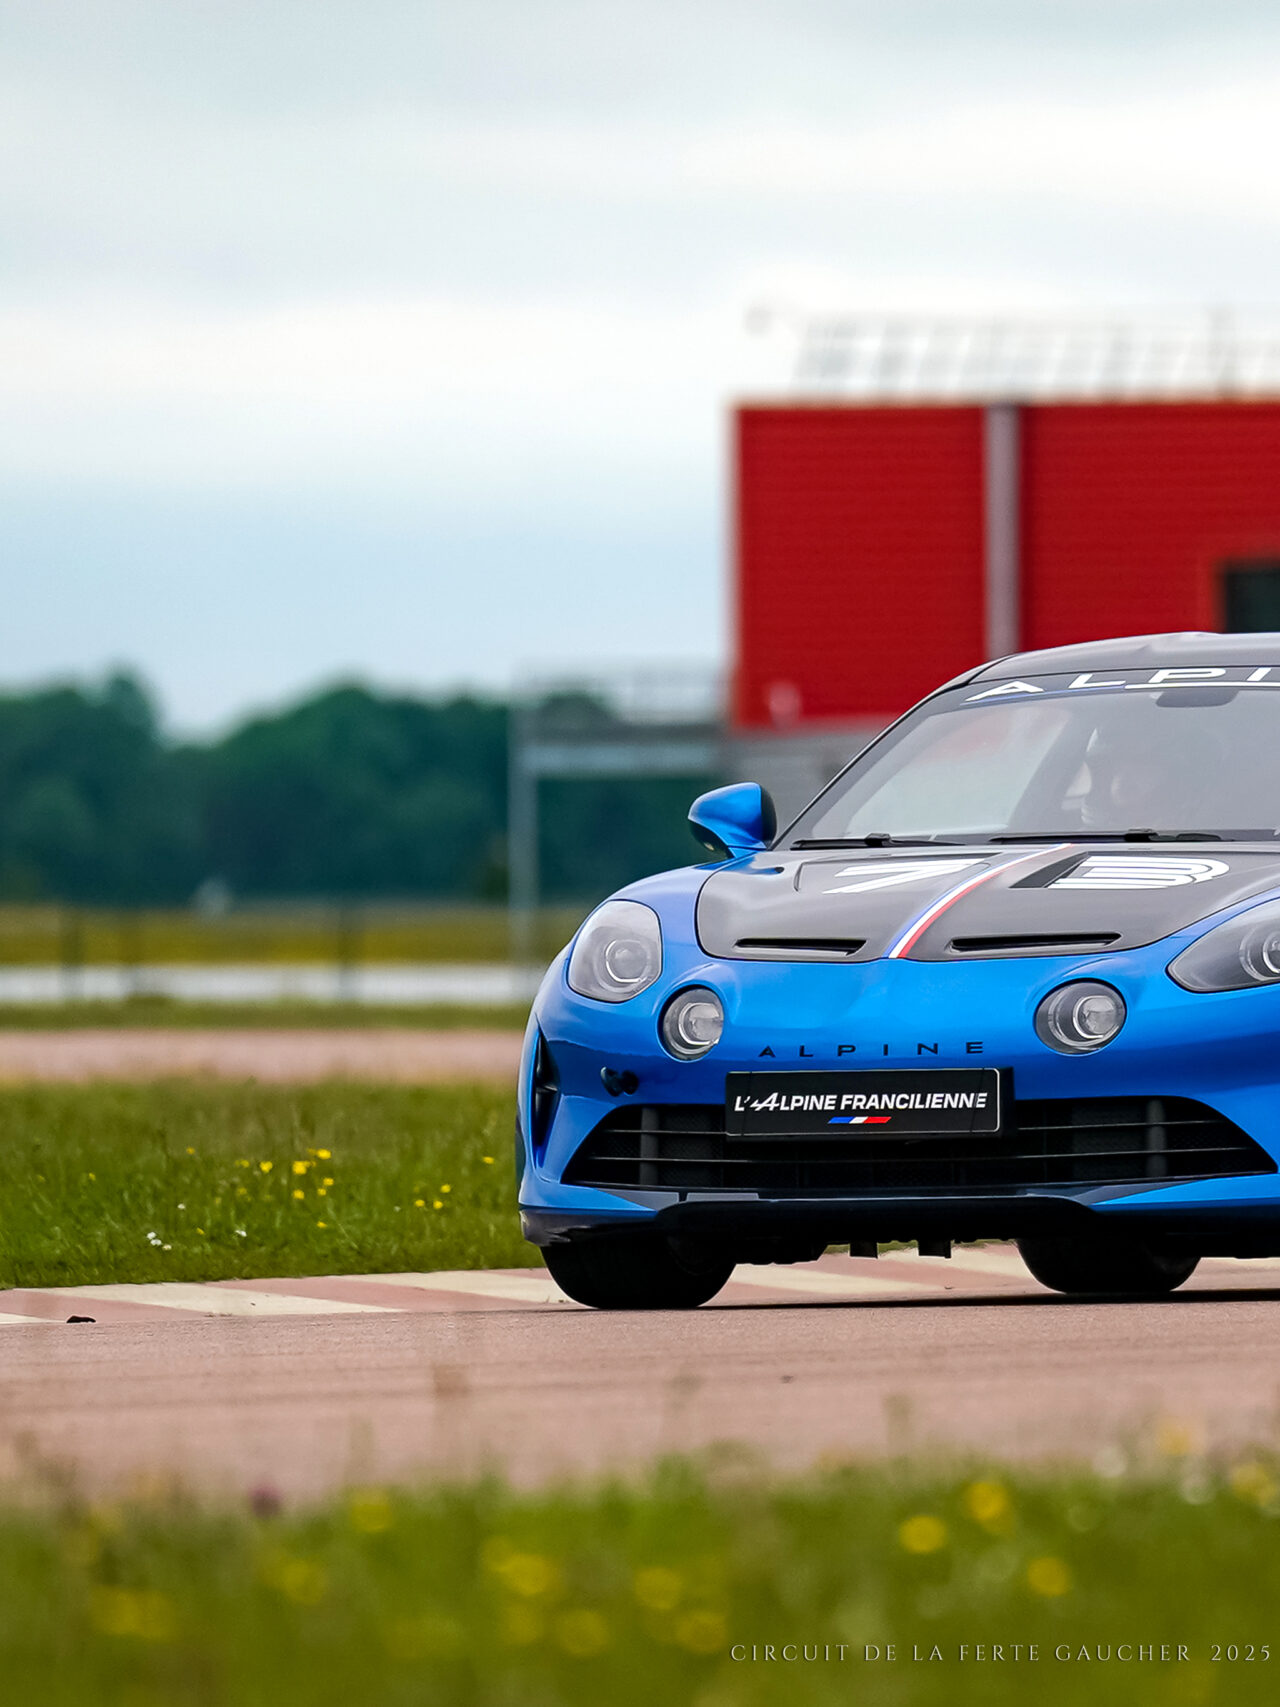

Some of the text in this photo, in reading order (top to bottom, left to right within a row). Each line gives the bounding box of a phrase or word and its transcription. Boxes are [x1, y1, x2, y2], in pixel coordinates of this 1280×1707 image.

[758, 1041, 984, 1058] ALPINE
[734, 1091, 988, 1112] L'ALPINE FRANCILIENNE
